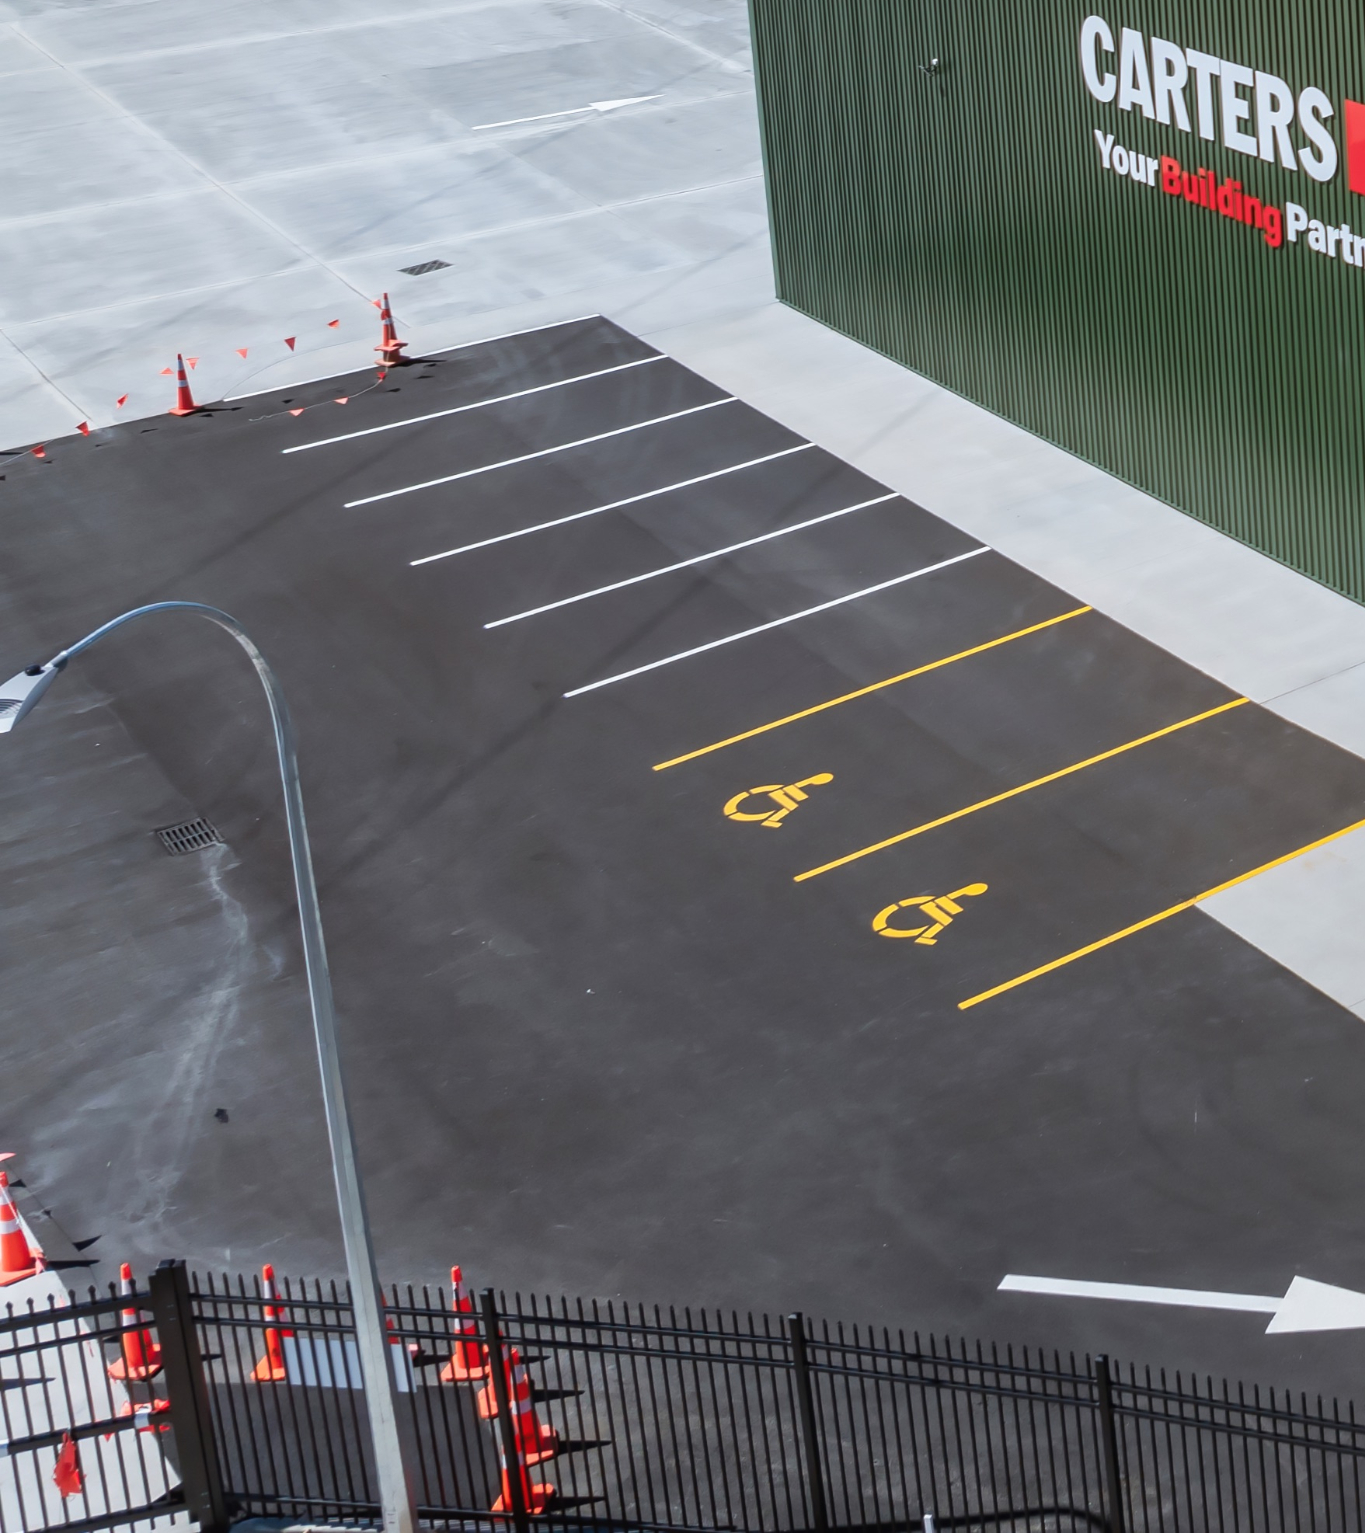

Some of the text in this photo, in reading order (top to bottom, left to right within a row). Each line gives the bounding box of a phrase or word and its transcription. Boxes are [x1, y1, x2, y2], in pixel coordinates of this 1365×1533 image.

[1080, 15, 1338, 182] CARTERS
[1094, 129, 1158, 187] Your
[1161, 155, 1284, 248] Building
